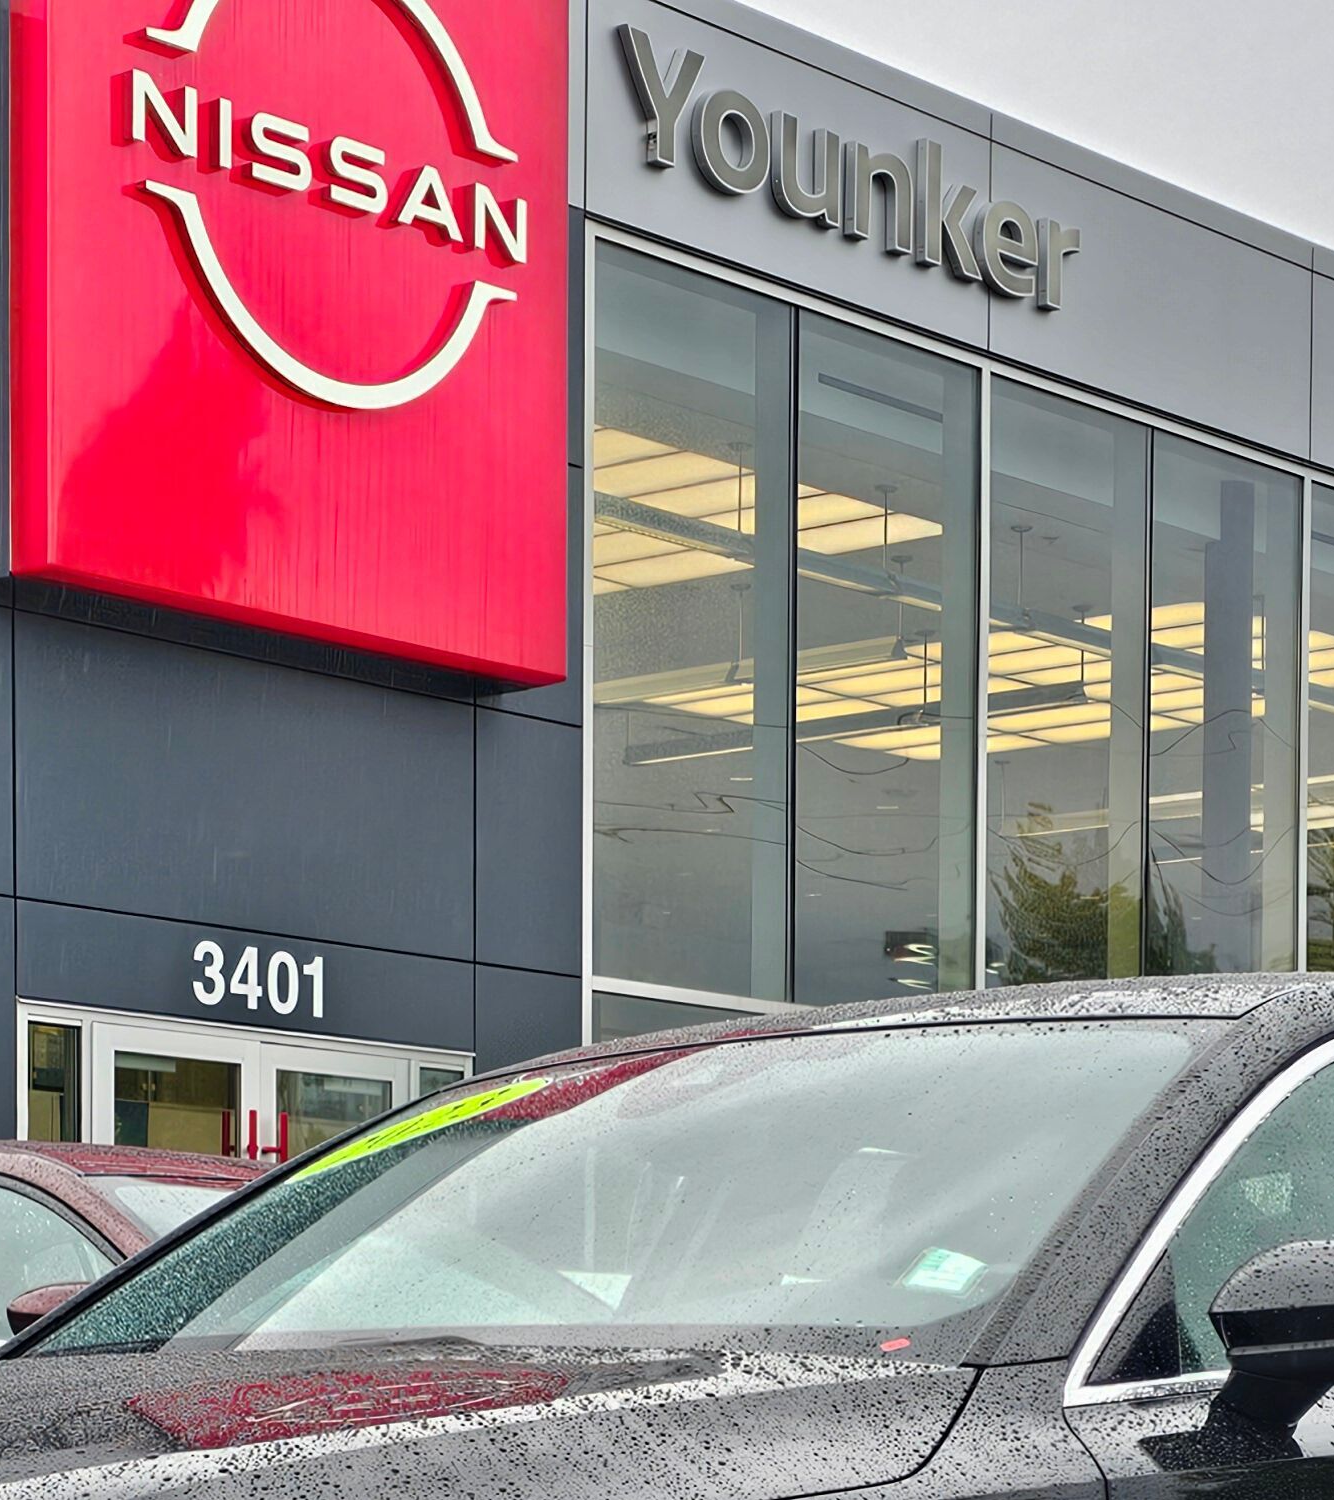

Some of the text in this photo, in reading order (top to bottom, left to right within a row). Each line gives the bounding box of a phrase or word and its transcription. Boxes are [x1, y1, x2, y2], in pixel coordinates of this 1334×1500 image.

[130, 67, 528, 265] NISSAN
[617, 22, 1081, 312] Younker
[192, 940, 325, 1018] 3401
